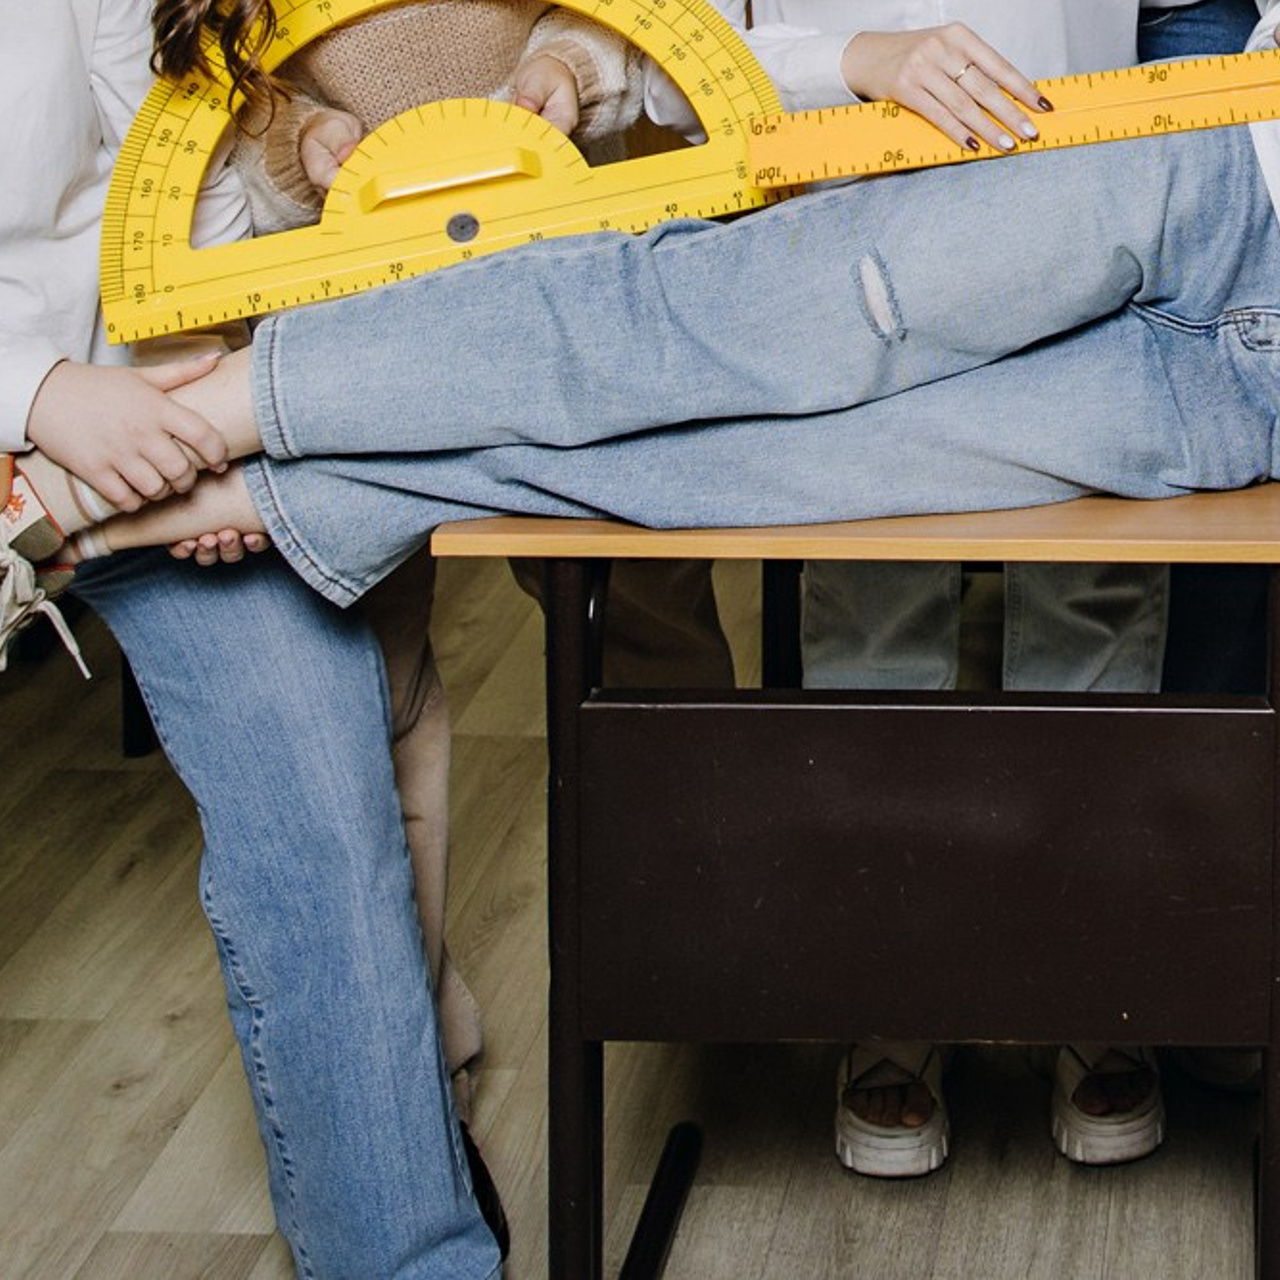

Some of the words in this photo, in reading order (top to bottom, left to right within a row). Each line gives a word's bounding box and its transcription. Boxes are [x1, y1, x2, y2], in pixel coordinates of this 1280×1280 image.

[317, 1, 331, 13] 70
[634, 14, 653, 30] 140
[275, 27, 290, 39] 60
[690, 29, 704, 42] 30
[669, 43, 687, 61] 150
[721, 67, 735, 81] 20
[183, 82, 201, 102] 140
[698, 78, 714, 96] 160
[882, 104, 900, 118] 10
[1148, 70, 1168, 84] 30
[207, 98, 222, 111] 40
[720, 118, 734, 136] 170
[1154, 114, 1174, 127] 70
[156, 129, 172, 148] 150
[184, 140, 198, 154] 30
[884, 150, 904, 163] 90
[735, 160, 748, 180] 180
[758, 166, 781, 180] 100
[141, 178, 154, 198] 160
[169, 186, 181, 200] 20
[133, 231, 145, 251] 170
[163, 233, 173, 247] 10
[107, 323, 116, 333] 0
[247, 293, 261, 304] 10
[389, 263, 404, 273] 20
[664, 203, 678, 213] 40
[732, 191, 743, 200] 45
[133, 284, 145, 304] 180
[164, 285, 175, 293] 0
